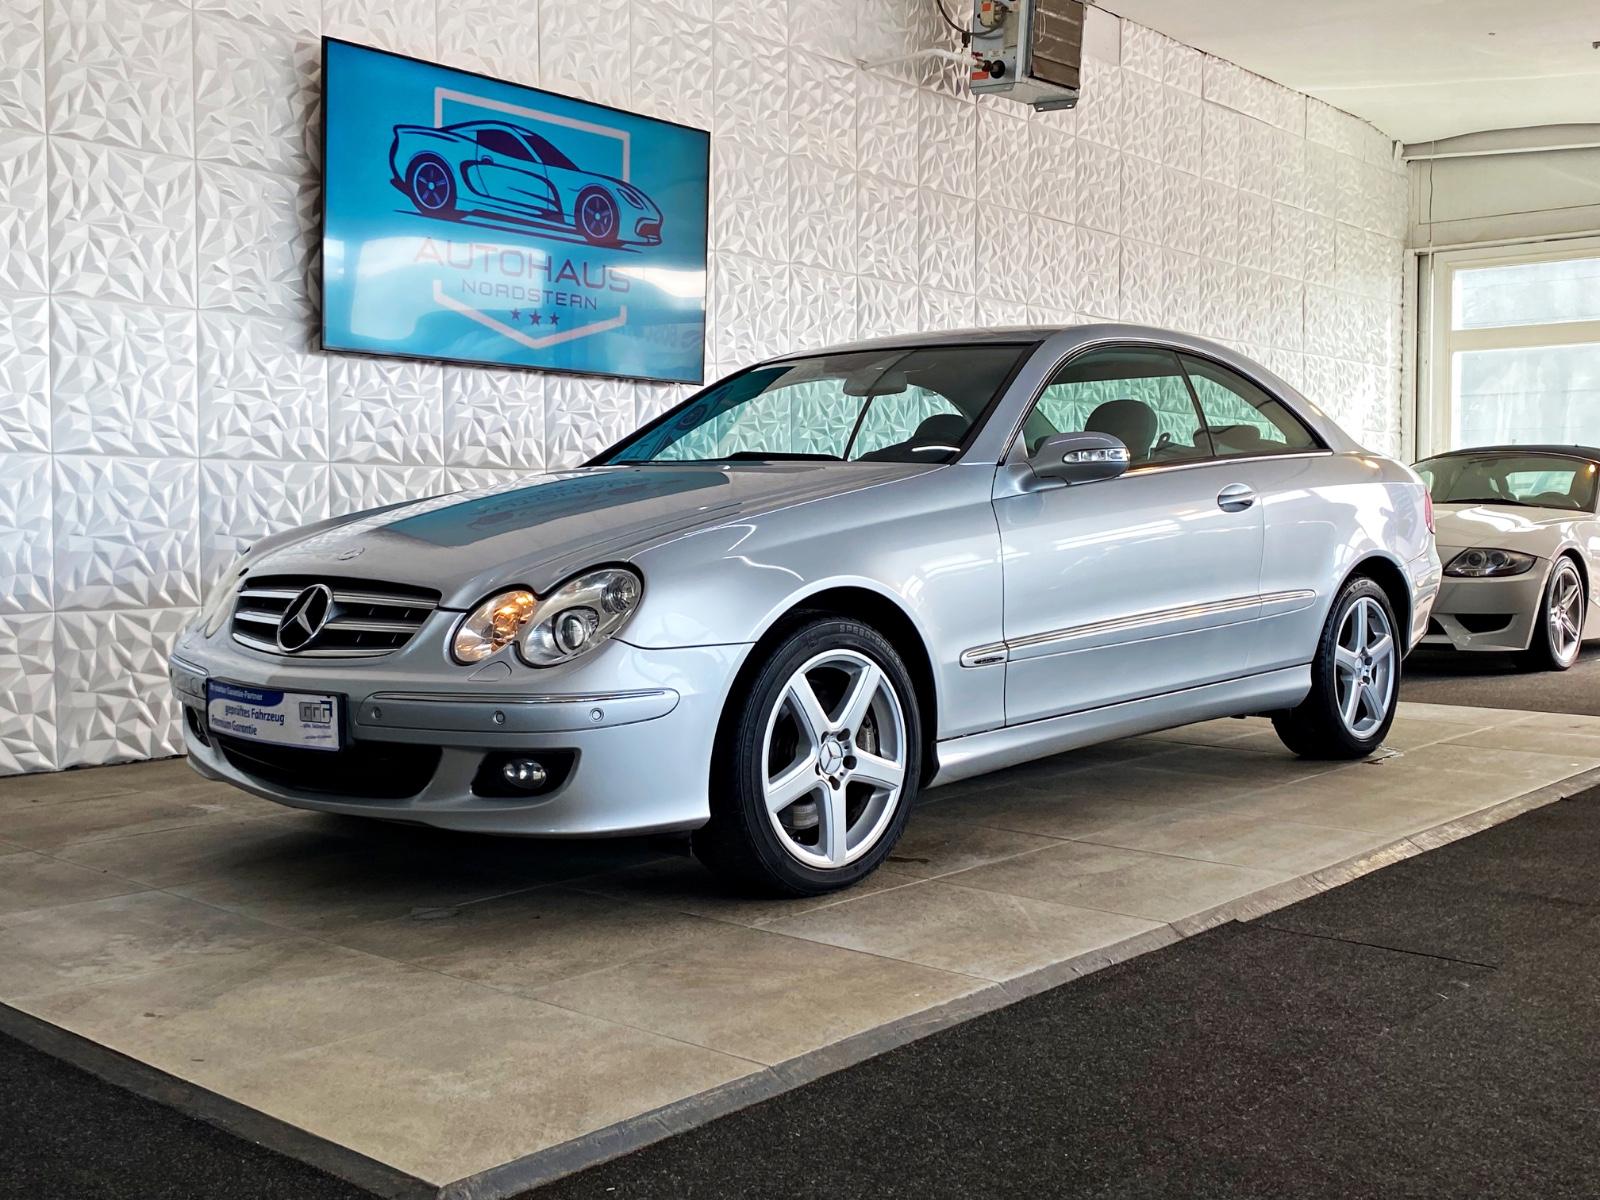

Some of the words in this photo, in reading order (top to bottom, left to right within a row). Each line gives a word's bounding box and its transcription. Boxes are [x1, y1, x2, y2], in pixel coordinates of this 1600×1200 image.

[414, 237, 631, 293] AUTOHAUS
[461, 279, 597, 311] NORDSTERN
[232, 720, 257, 735] Garantie
[251, 708, 285, 726] Fahrzeug
